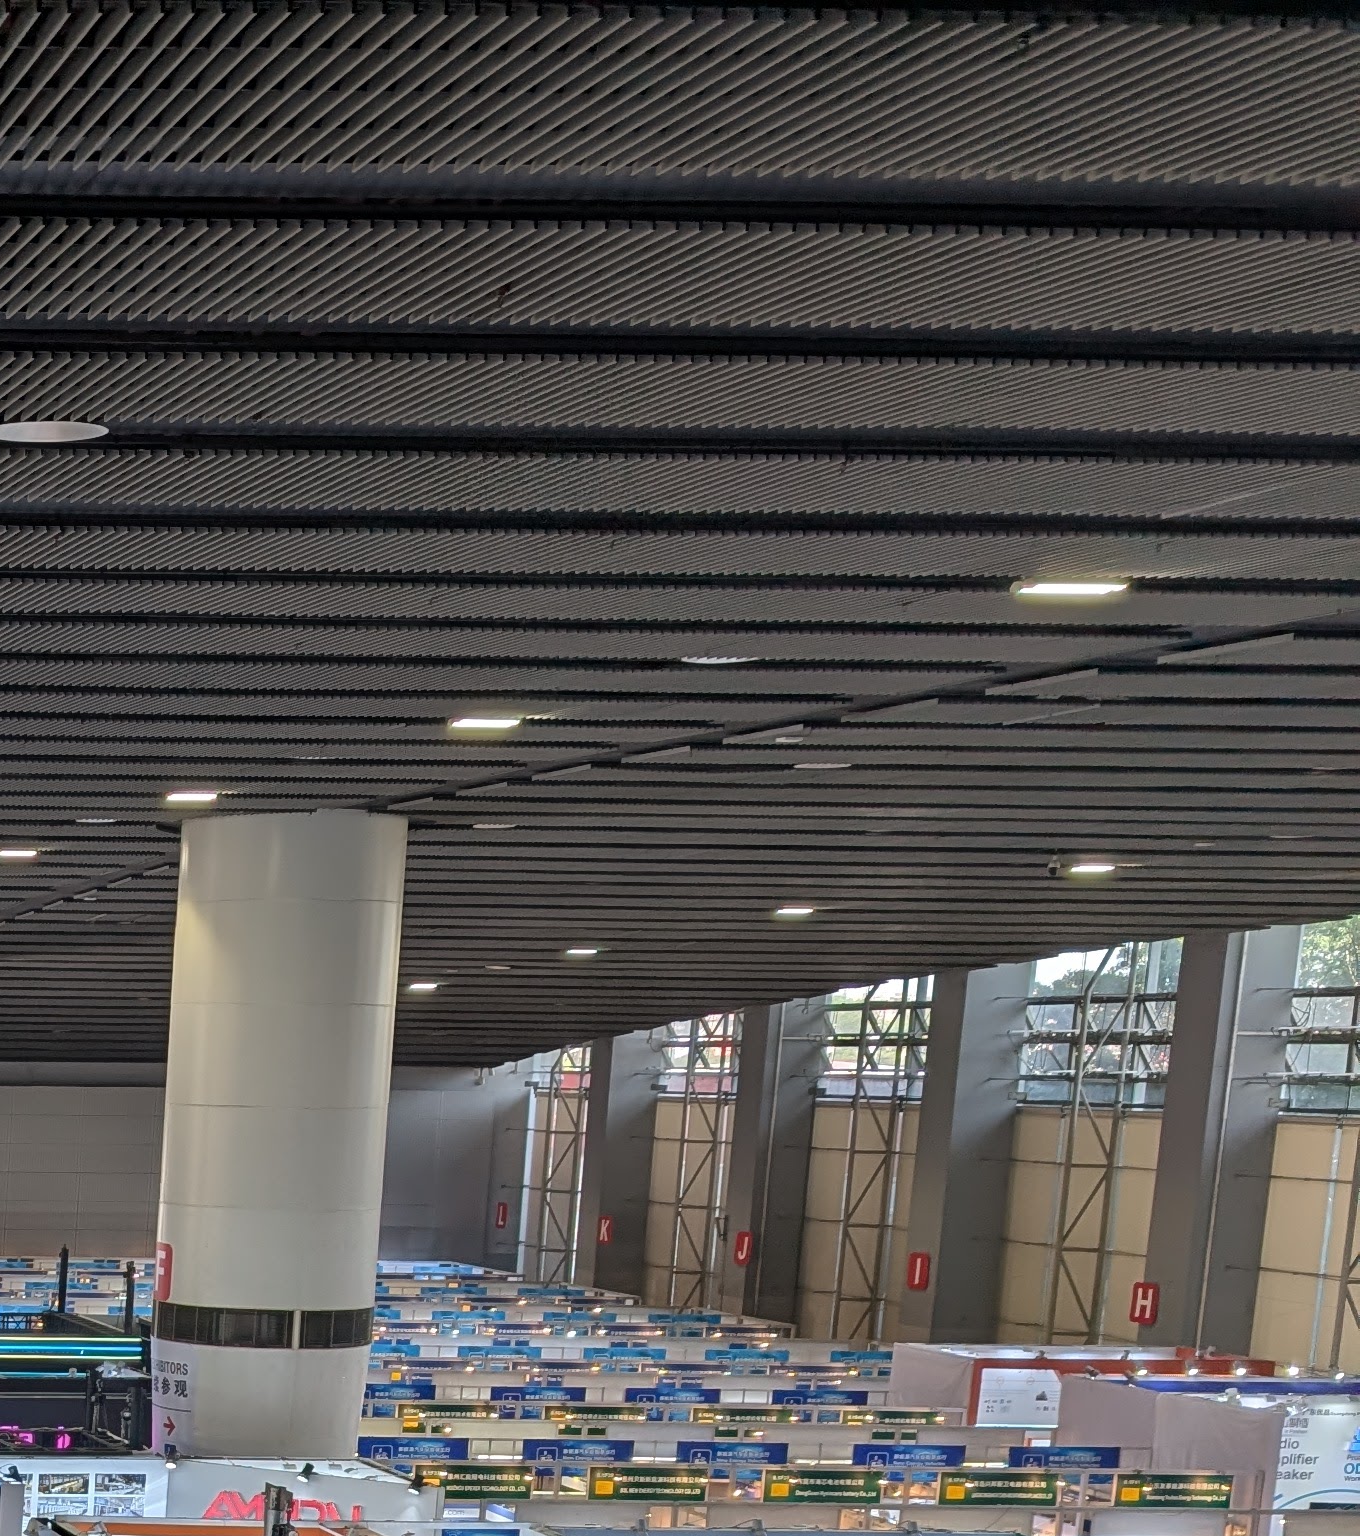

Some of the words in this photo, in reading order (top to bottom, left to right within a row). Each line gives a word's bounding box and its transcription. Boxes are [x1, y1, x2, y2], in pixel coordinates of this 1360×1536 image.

[497, 1207, 505, 1225] L
[600, 1219, 610, 1241] K
[737, 1237, 749, 1260] J
[1136, 1288, 1154, 1319] H
[1281, 1454, 1320, 1467] plifier
